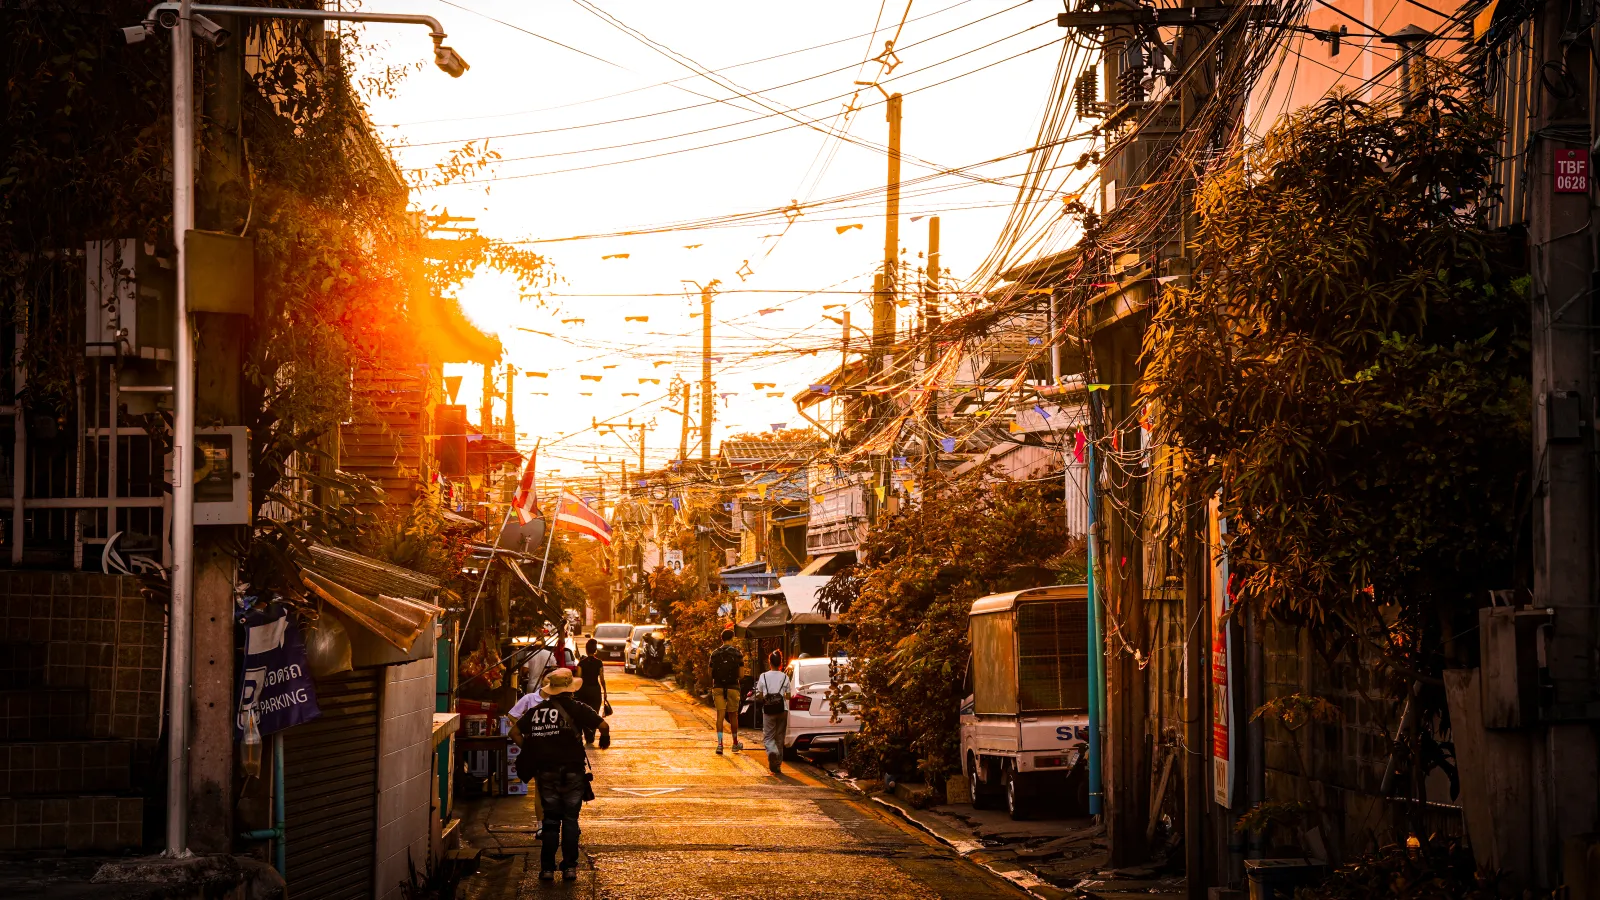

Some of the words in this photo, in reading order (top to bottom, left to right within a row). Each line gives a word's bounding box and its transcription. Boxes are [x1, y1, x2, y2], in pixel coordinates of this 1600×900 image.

[1557, 160, 1586, 174] TBF
[1557, 175, 1586, 190] 0628
[260, 687, 308, 715] PARKING
[531, 707, 559, 724] 479
